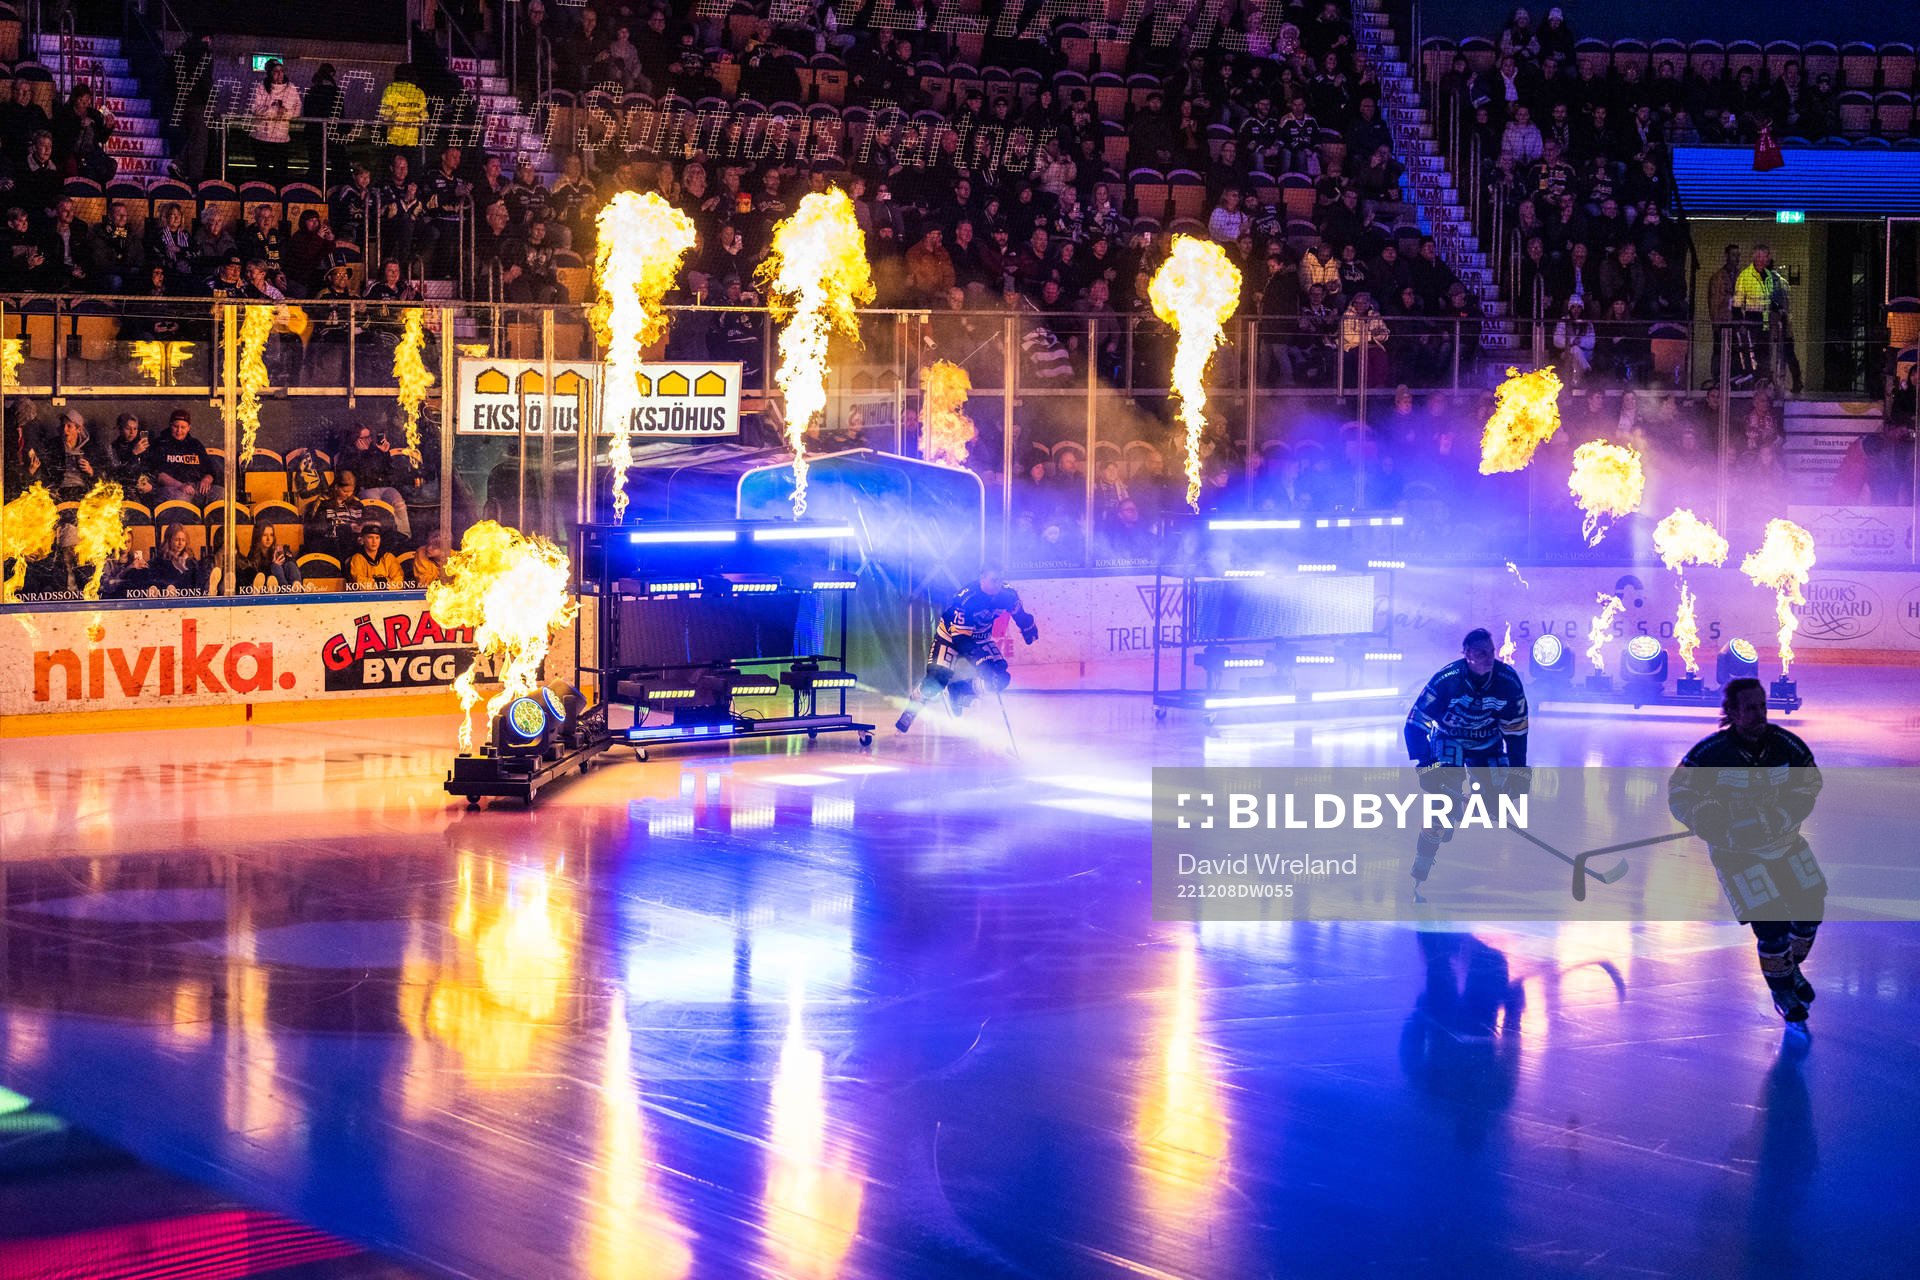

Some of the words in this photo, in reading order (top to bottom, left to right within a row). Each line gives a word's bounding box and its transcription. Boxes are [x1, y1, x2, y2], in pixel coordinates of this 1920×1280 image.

[108, 138, 144, 150] MAXI
[629, 401, 727, 432] KSJÖHUS
[239, 583, 312, 595] KONRADSSONS
[344, 580, 416, 592] KONRADSSONS
[13, 590, 85, 602] ONRADSSONS
[126, 588, 202, 599] KONRADSSONS
[1807, 585, 1856, 602] HOOKS
[1518, 620, 1721, 640] svessos
[321, 610, 476, 672] GÄRAH
[362, 654, 456, 685] BYGG
